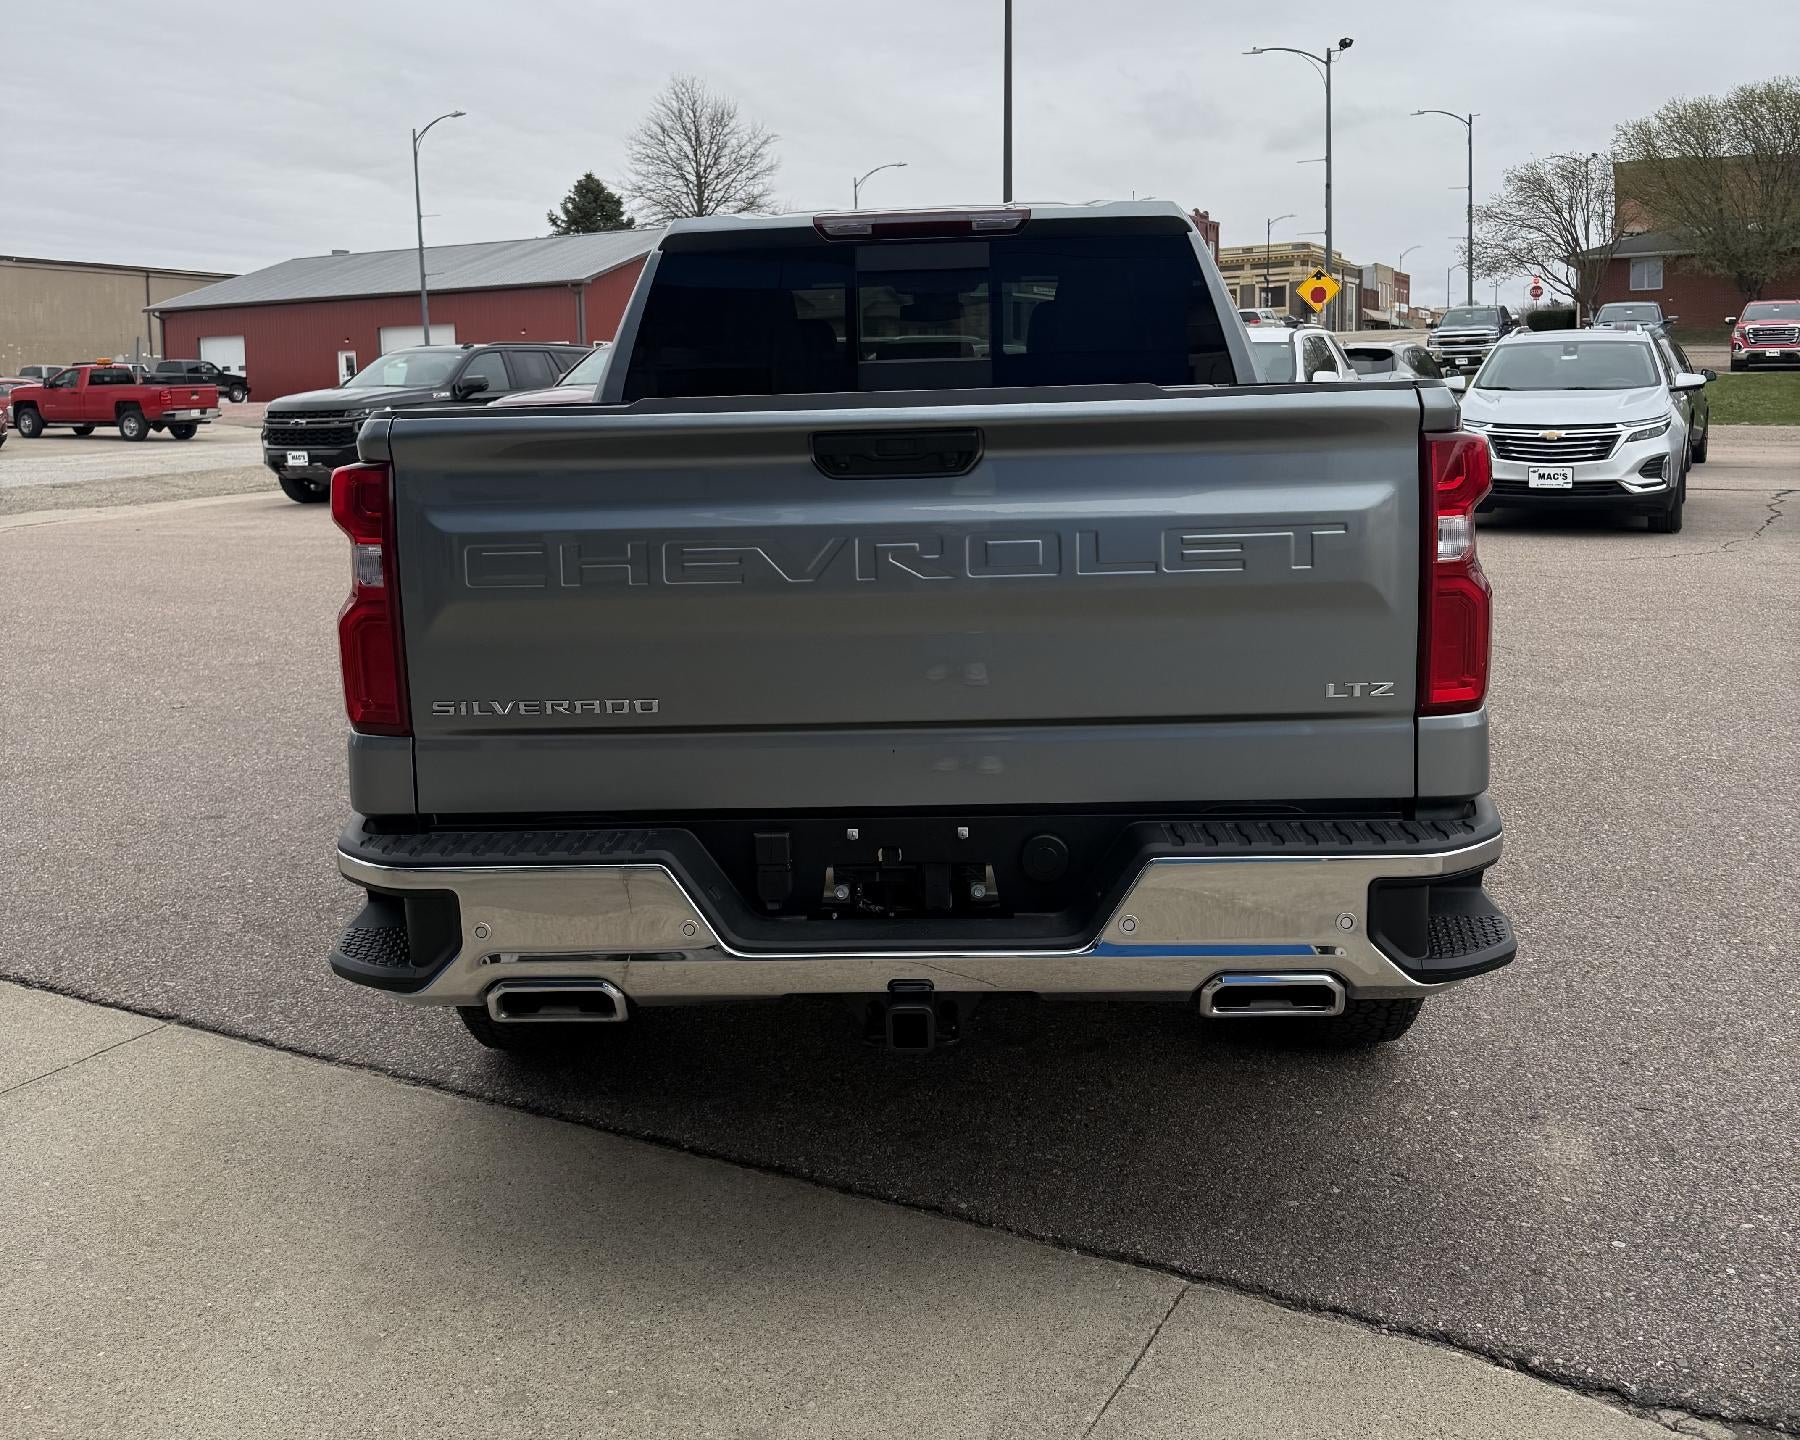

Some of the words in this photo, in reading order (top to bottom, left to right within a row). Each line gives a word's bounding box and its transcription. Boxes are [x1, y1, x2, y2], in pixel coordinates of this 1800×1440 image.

[1537, 472, 1568, 481] MAC'S
[463, 522, 1349, 589] CHEVROLET
[1325, 681, 1395, 698] LTZ
[432, 699, 659, 716] SILVERADO
